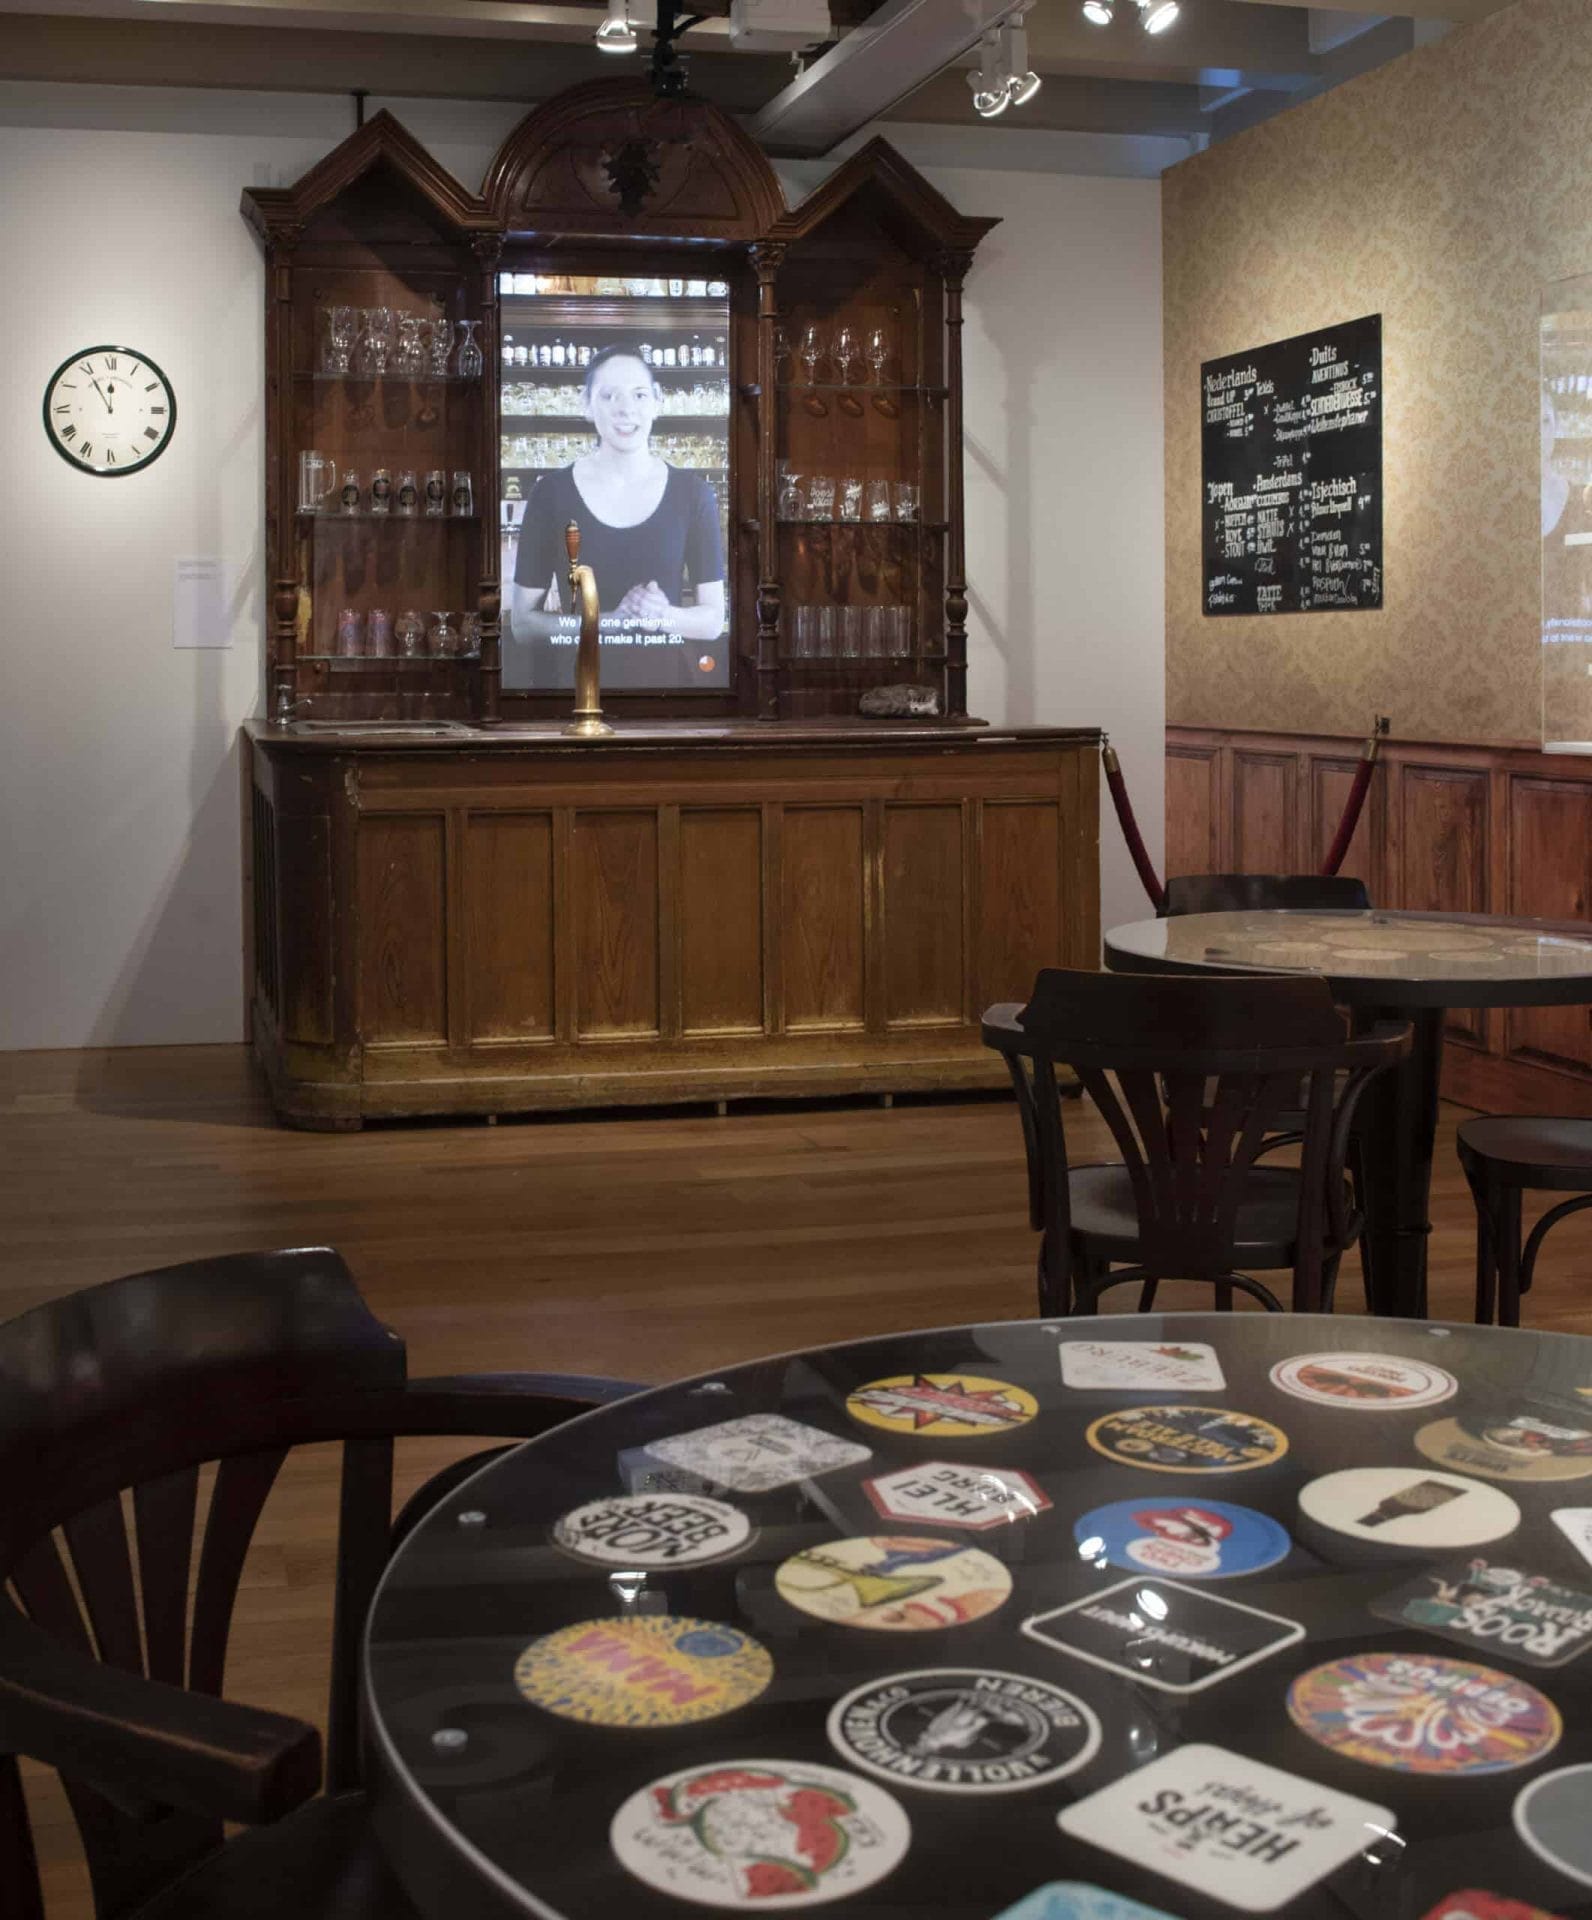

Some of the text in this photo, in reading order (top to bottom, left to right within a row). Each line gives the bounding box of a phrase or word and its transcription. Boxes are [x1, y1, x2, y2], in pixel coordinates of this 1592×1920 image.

[1312, 345, 1337, 366] Duits
[1206, 365, 1257, 392] Nederlands
[559, 616, 576, 628] We
[600, 616, 676, 629] one gentleman
[550, 633, 570, 644] who
[604, 633, 633, 644] make
[636, 633, 642, 644] it
[645, 633, 666, 646] past
[669, 634, 684, 644] 20.
[623, 1502, 729, 1544] BEER
[580, 1511, 699, 1558] MORE
